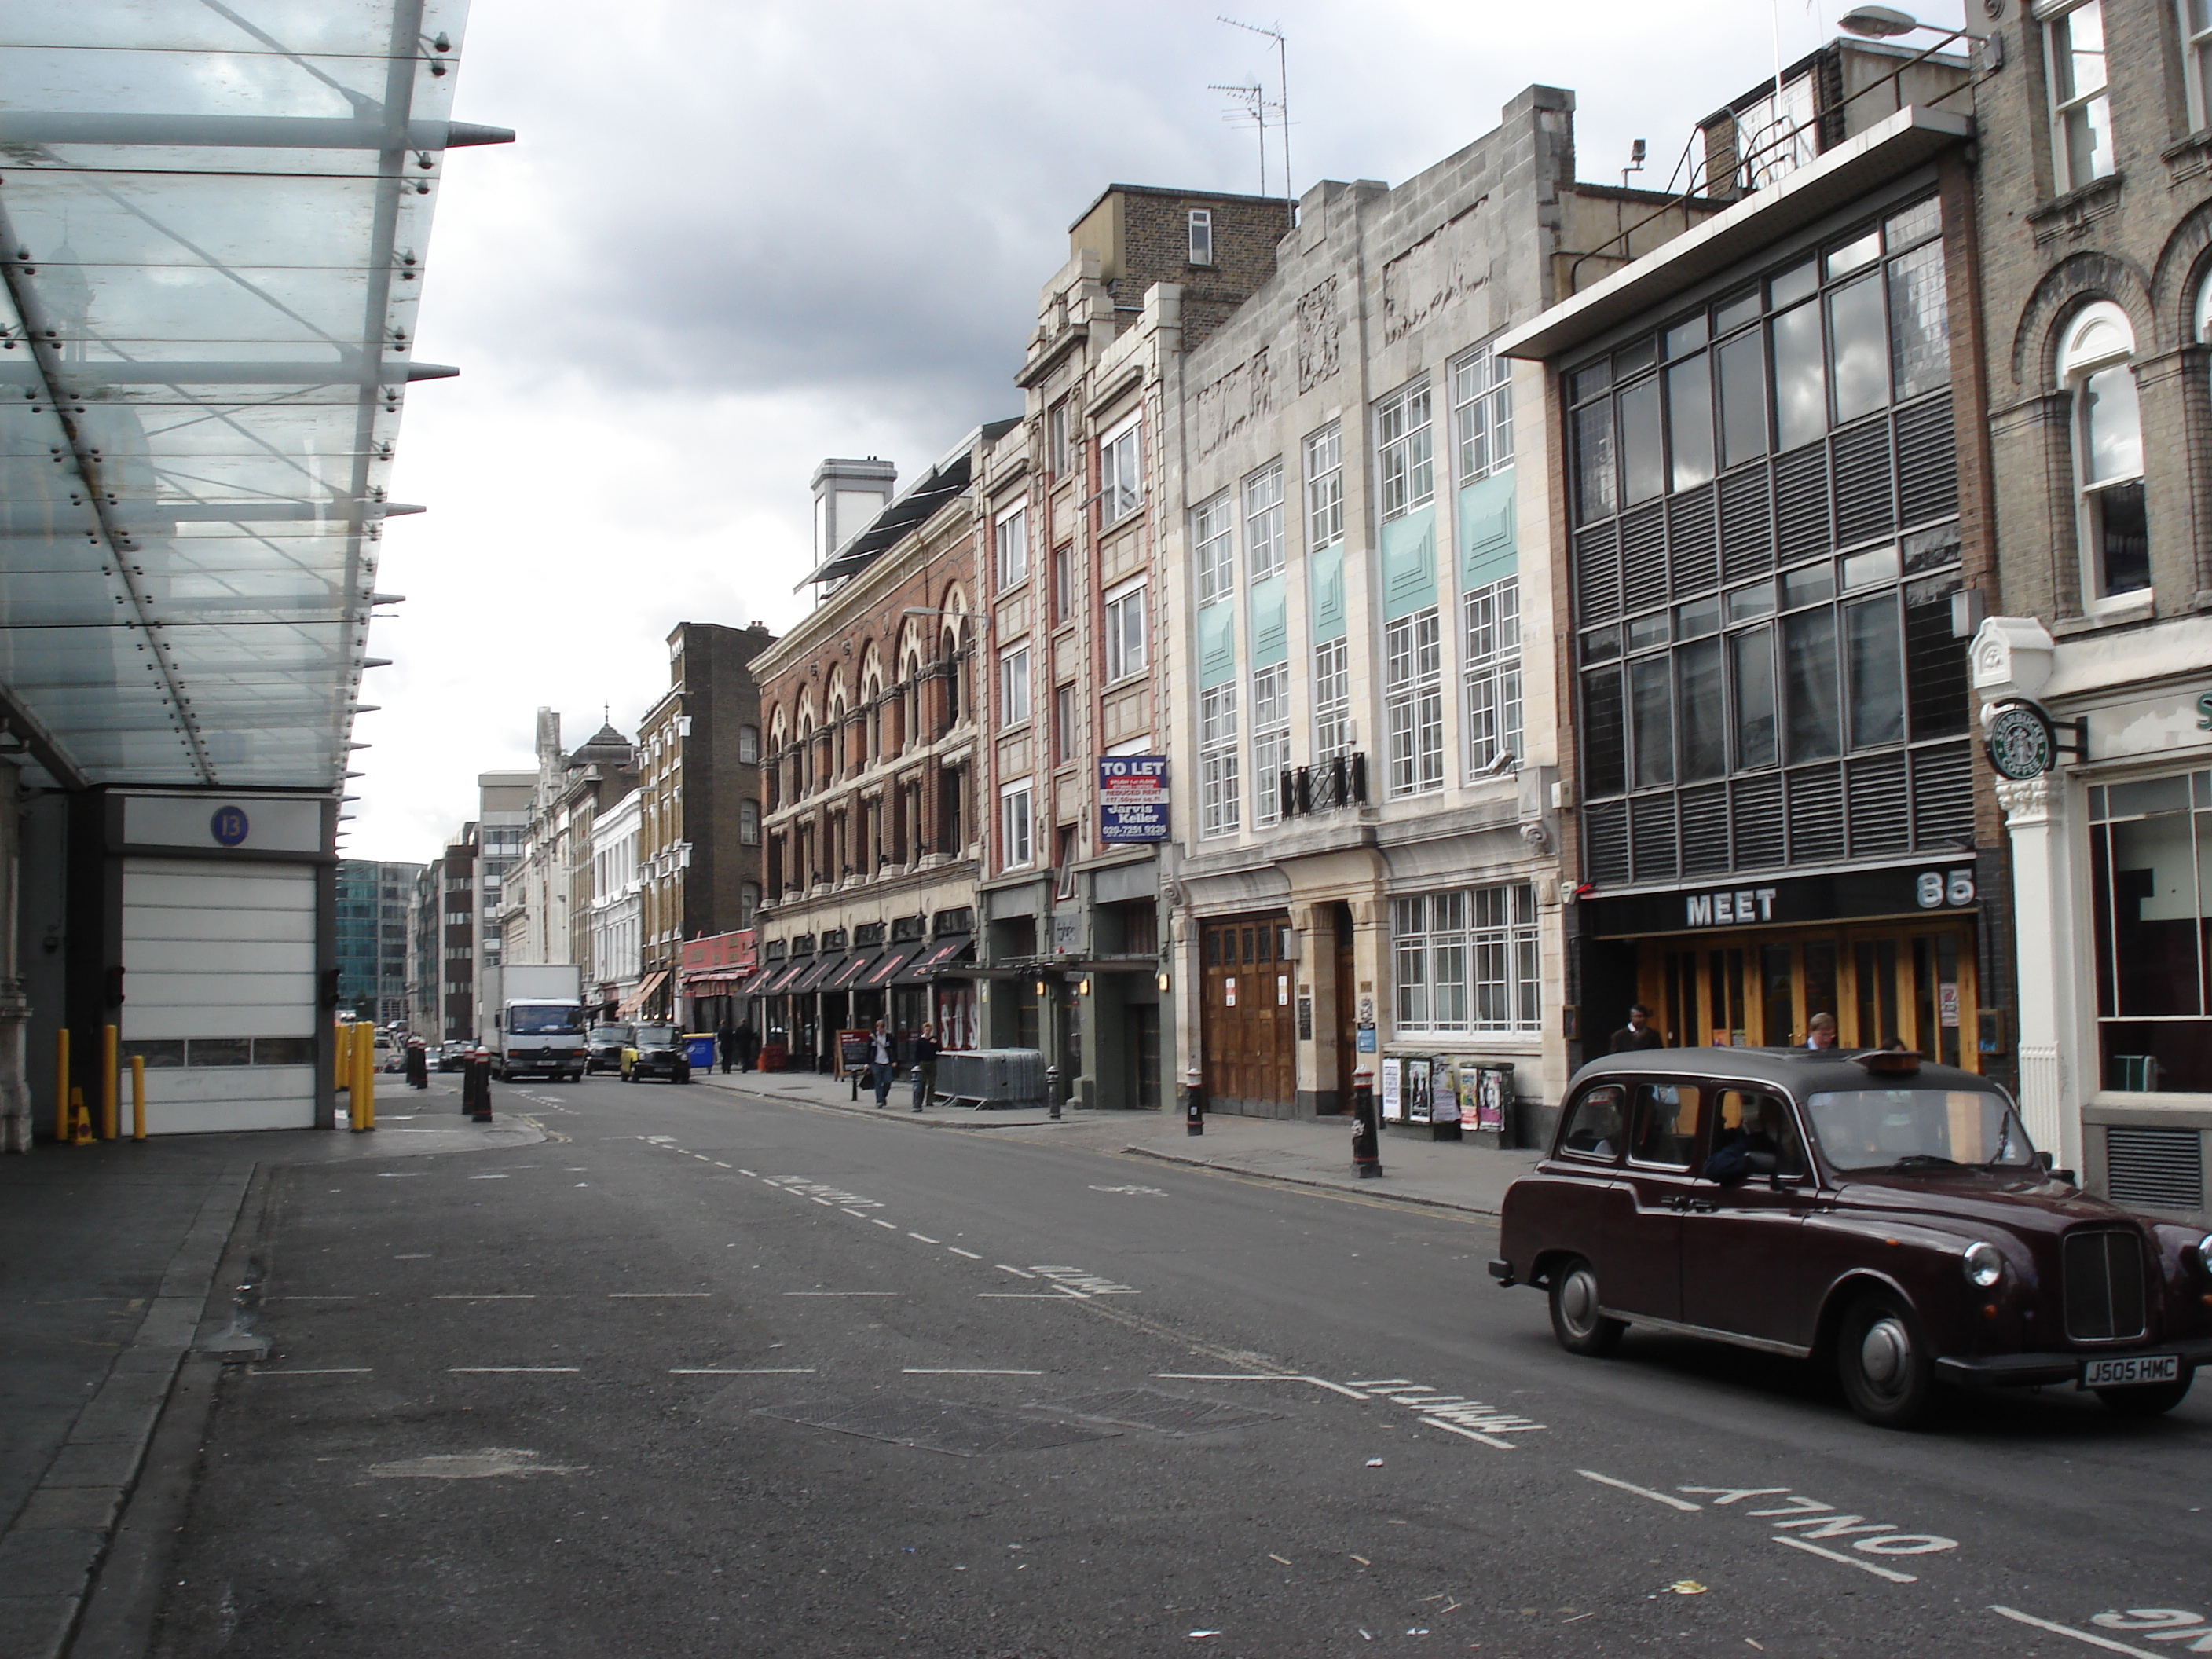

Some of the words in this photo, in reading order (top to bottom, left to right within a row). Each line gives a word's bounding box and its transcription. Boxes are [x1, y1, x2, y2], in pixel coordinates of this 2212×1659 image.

[1995, 712, 2045, 743] STARBUCKS
[1101, 761, 1127, 776] TO
[1131, 761, 1164, 776] LET
[2002, 757, 2042, 777] COFFEE
[1108, 804, 1153, 814] Jarvis
[1118, 814, 1159, 823] Keller
[222, 815, 241, 837] 13
[1686, 888, 1777, 927] MEET
[1916, 868, 1974, 909] 85
[2089, 1361, 2136, 1382] J505
[2139, 1358, 2175, 1379] HMC
[1676, 1485, 1960, 1556] ONLY
